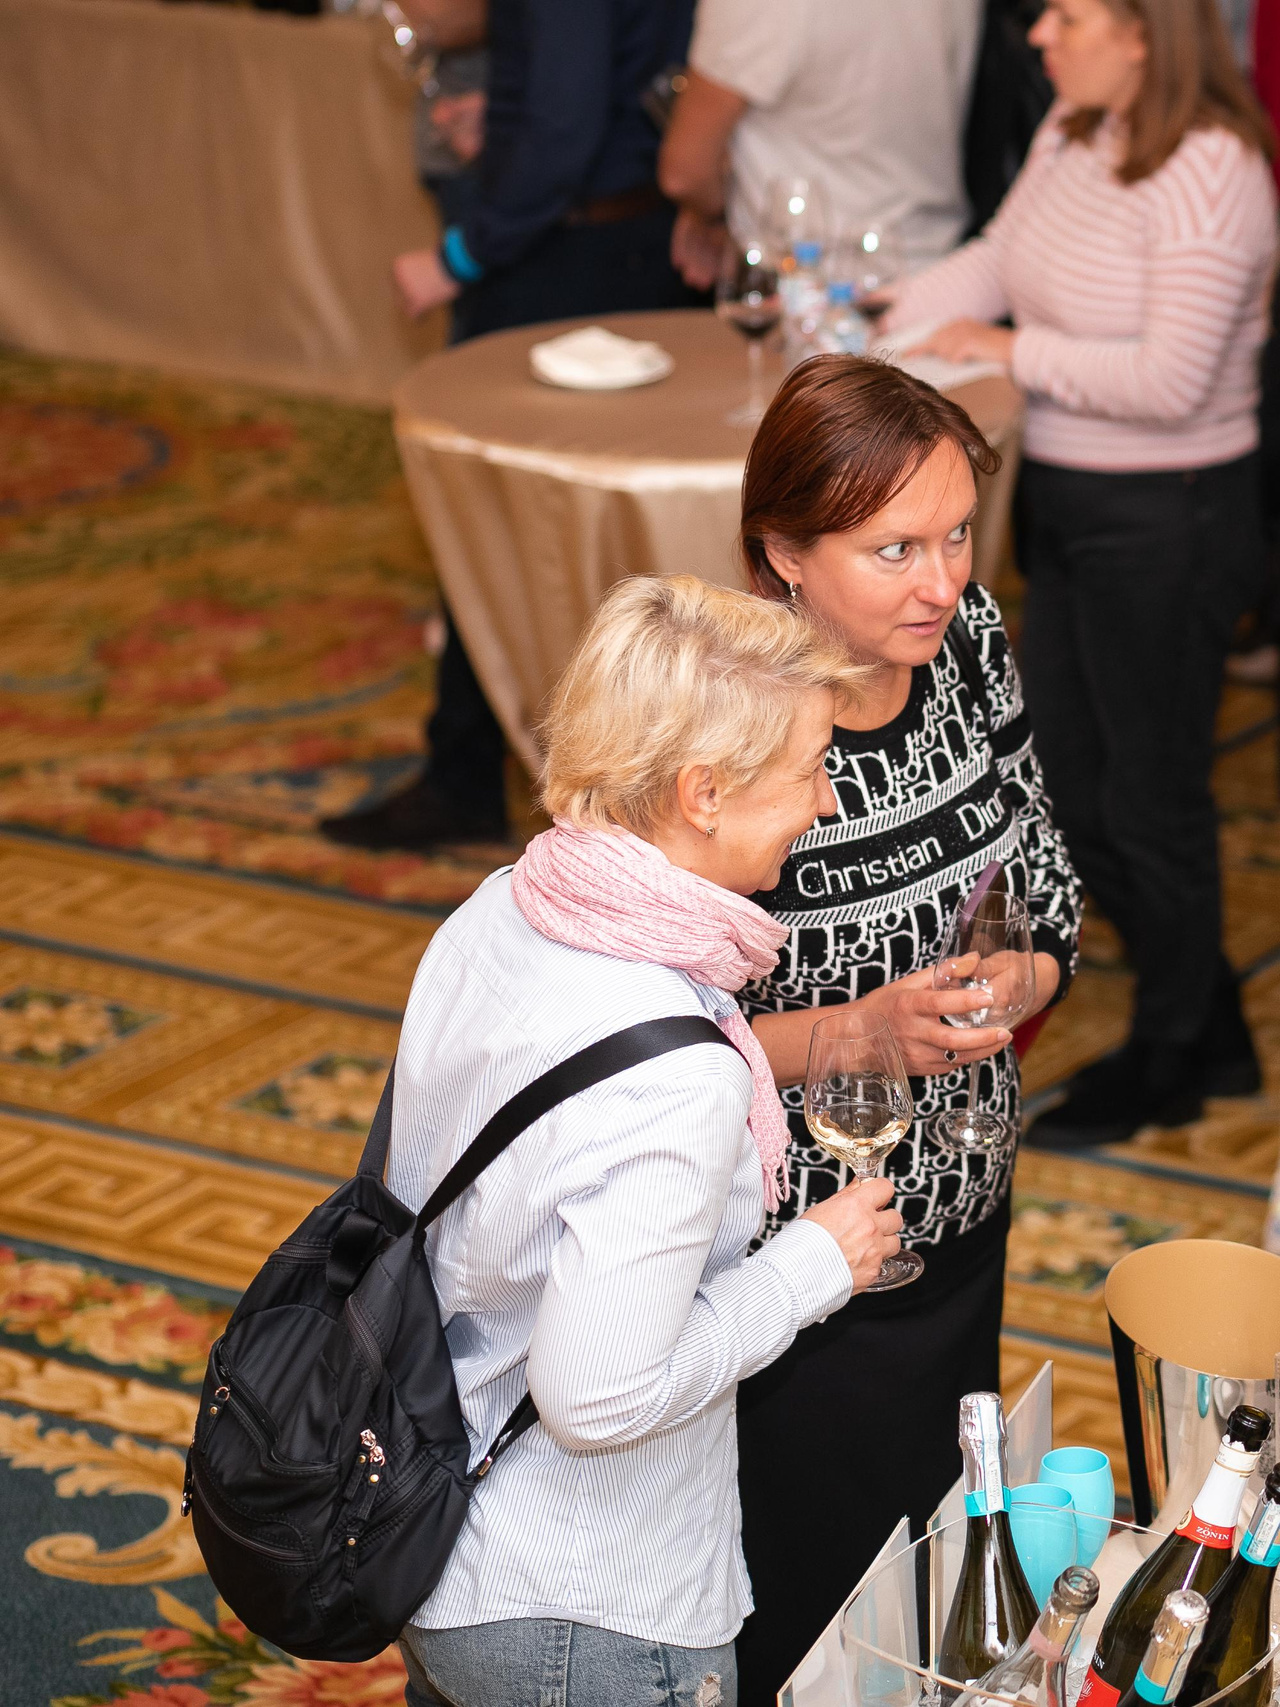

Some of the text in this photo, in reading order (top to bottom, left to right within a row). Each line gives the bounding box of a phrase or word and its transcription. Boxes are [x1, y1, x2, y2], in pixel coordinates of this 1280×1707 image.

[796, 788, 1005, 898] Christian Dior
[1196, 1526, 1230, 1540] ZONIN
